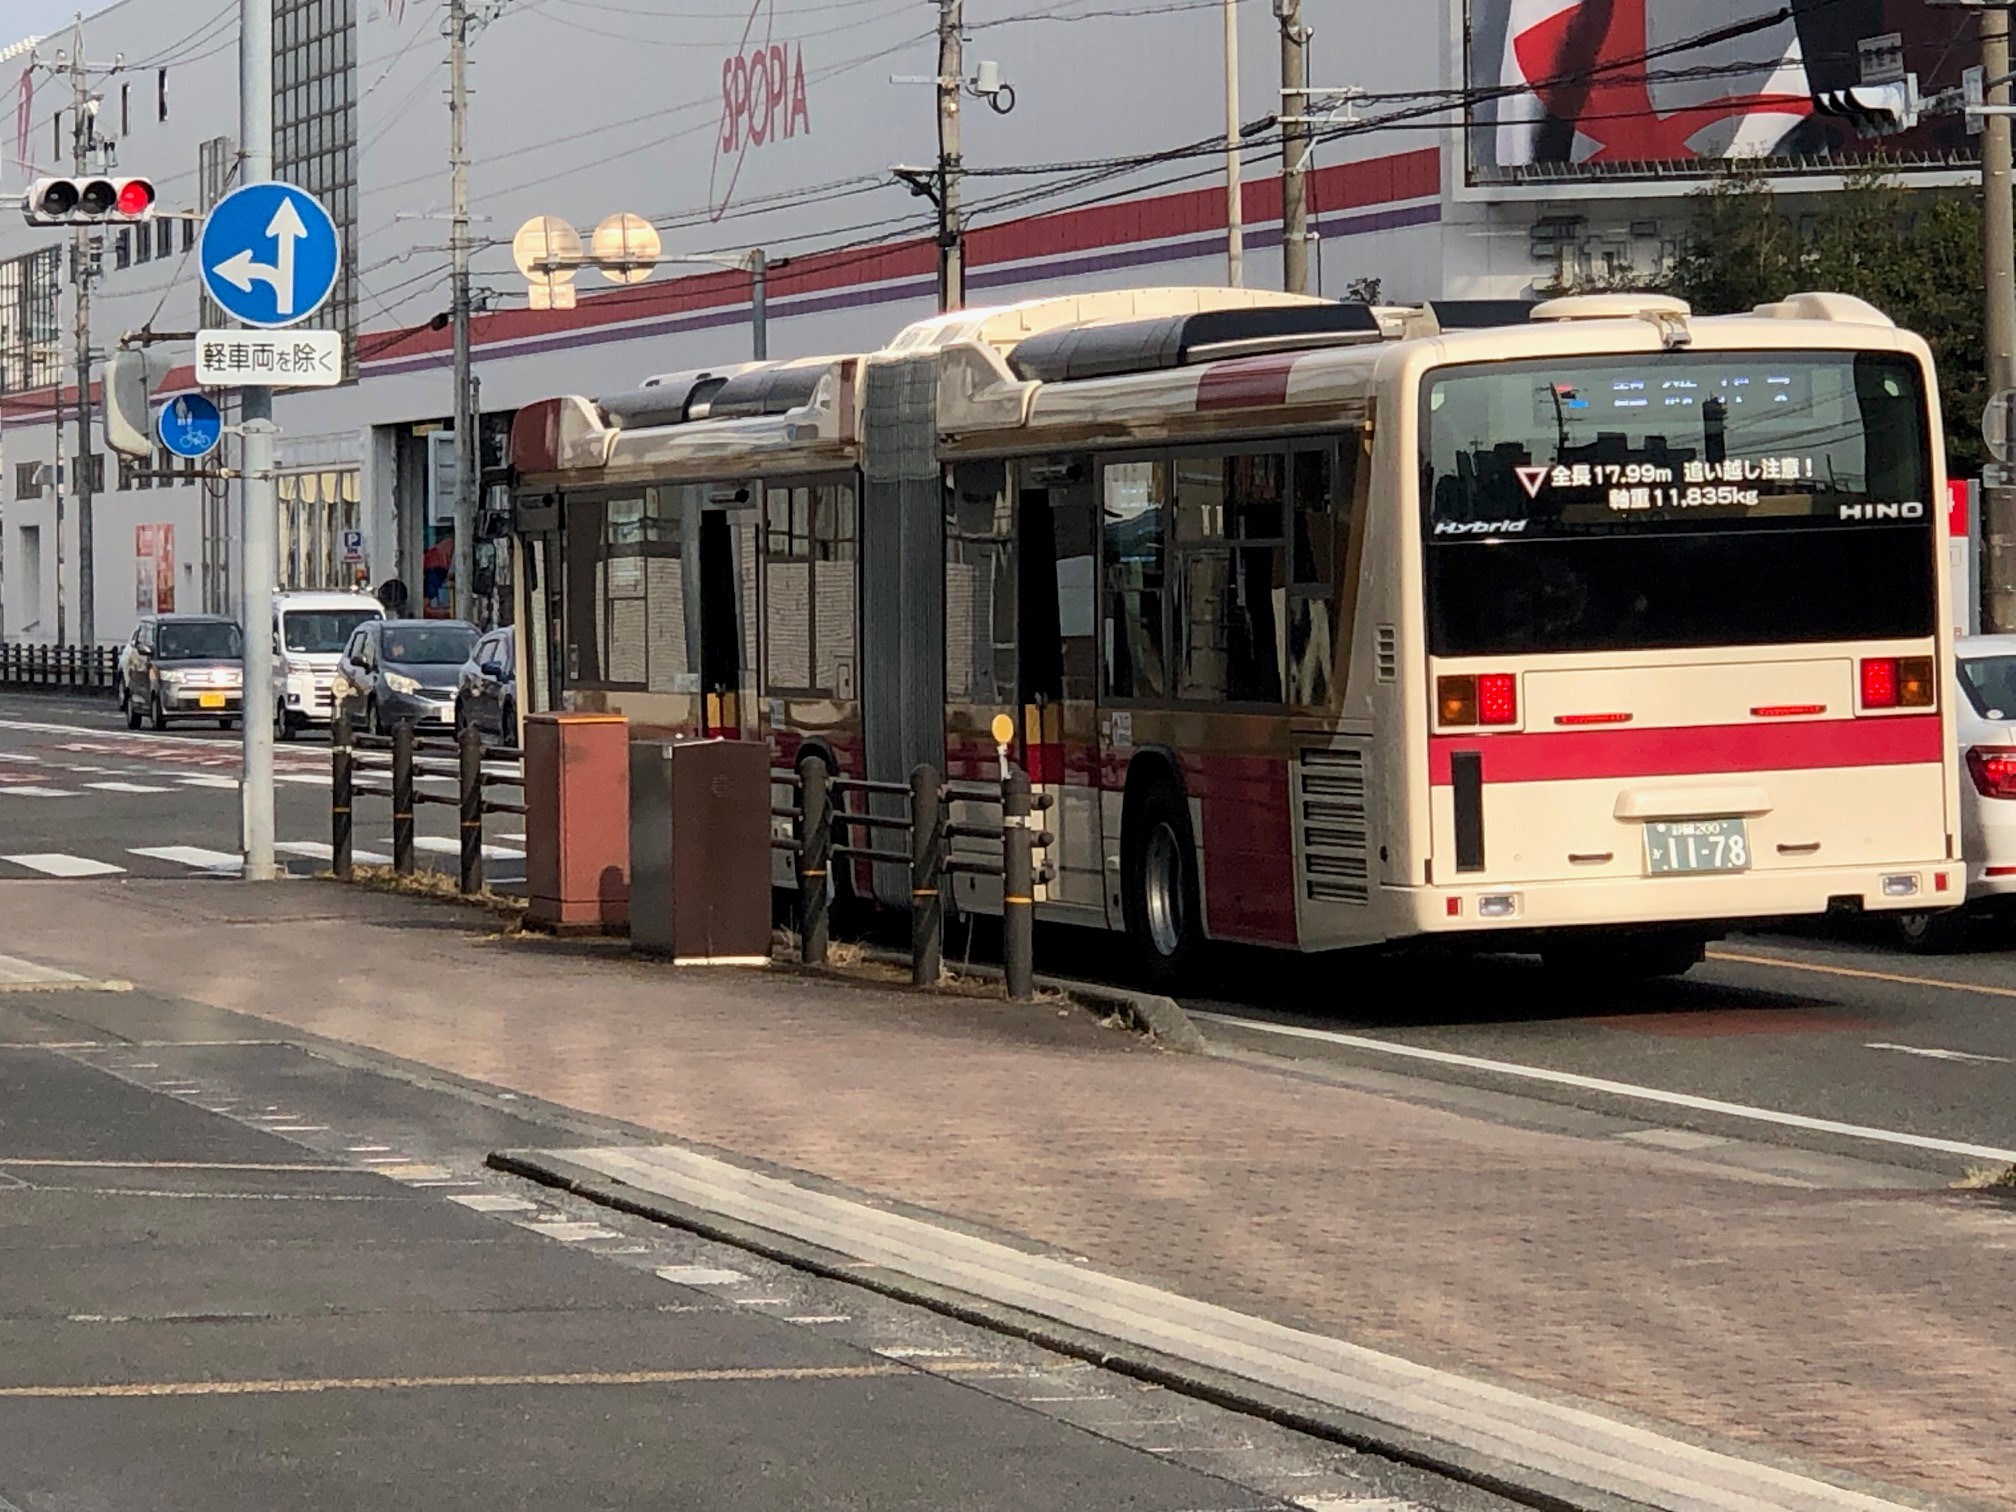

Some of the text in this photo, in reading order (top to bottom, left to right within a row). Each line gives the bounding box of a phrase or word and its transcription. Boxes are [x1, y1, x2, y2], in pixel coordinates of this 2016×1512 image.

[722, 41, 810, 154] SPOPIA
[203, 342, 333, 373] 軽車両を除く
[1551, 457, 1814, 488] 全長17.99m 追い越し注意！
[1608, 486, 1759, 510] 軸重11,835kg
[1840, 502, 1924, 520] HINO
[1433, 519, 1529, 534] Hybrid
[1668, 835, 1746, 868] 11-78
